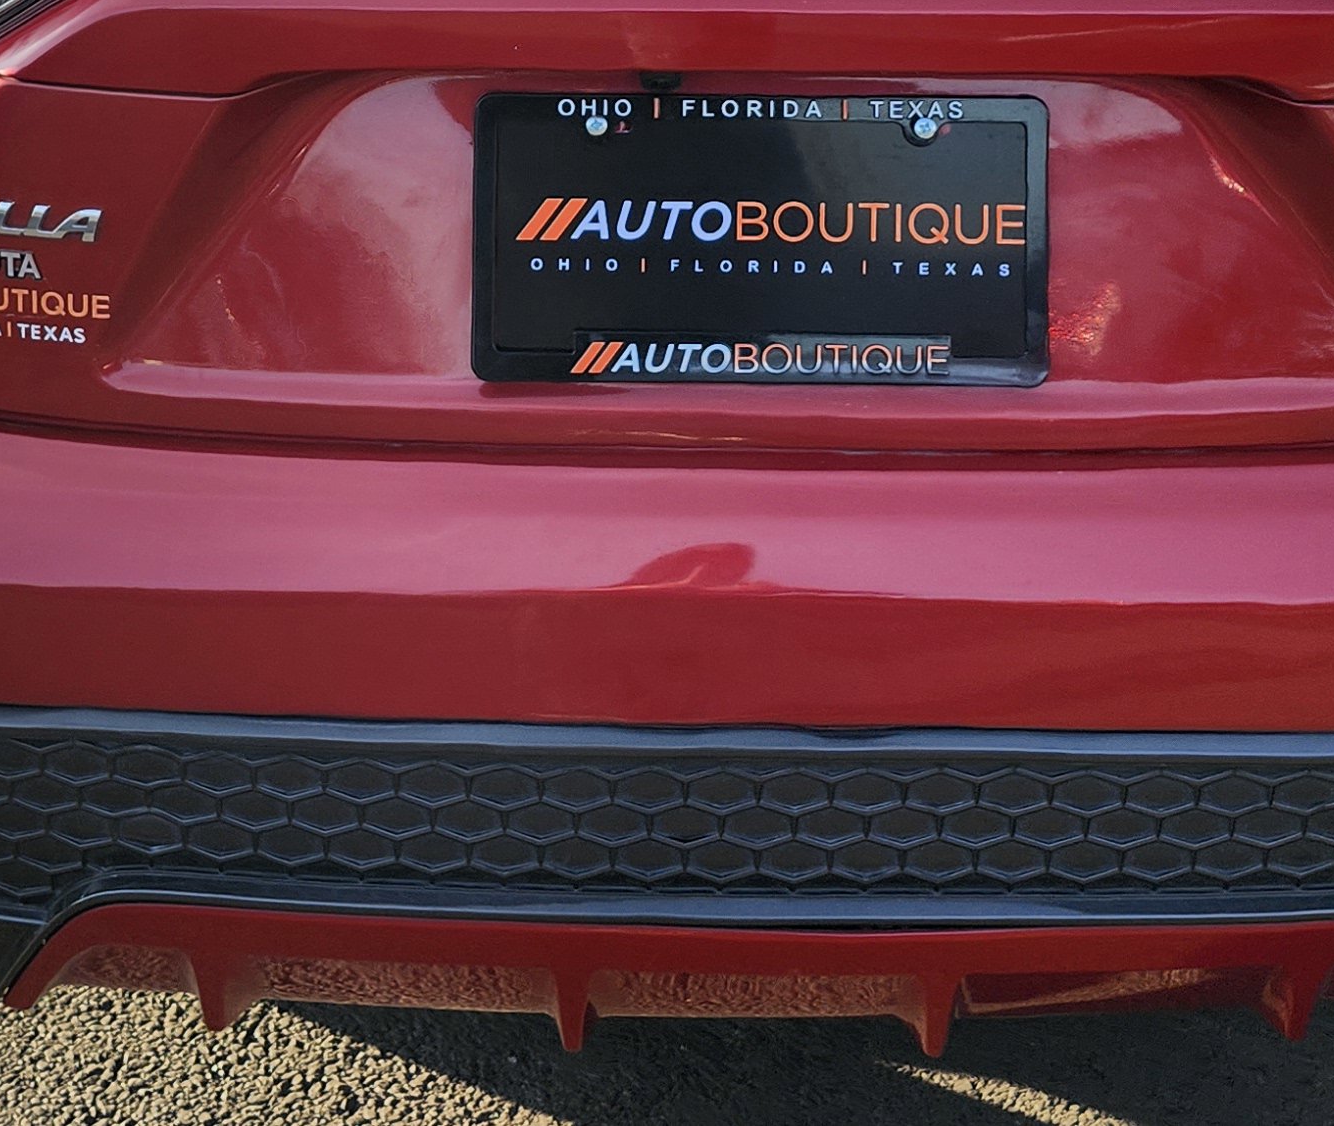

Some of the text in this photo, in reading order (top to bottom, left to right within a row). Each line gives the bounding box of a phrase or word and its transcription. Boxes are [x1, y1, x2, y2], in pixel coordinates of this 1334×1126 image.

[557, 98, 965, 120] OHIO FLORIDA TEXAS
[570, 199, 1027, 246] AUTOBOUTIQUE
[530, 257, 1011, 277] OHIO FLORIDA TEXAS
[17, 322, 86, 344] TEXAS
[610, 342, 950, 376] AUTOBOUTIQUE
